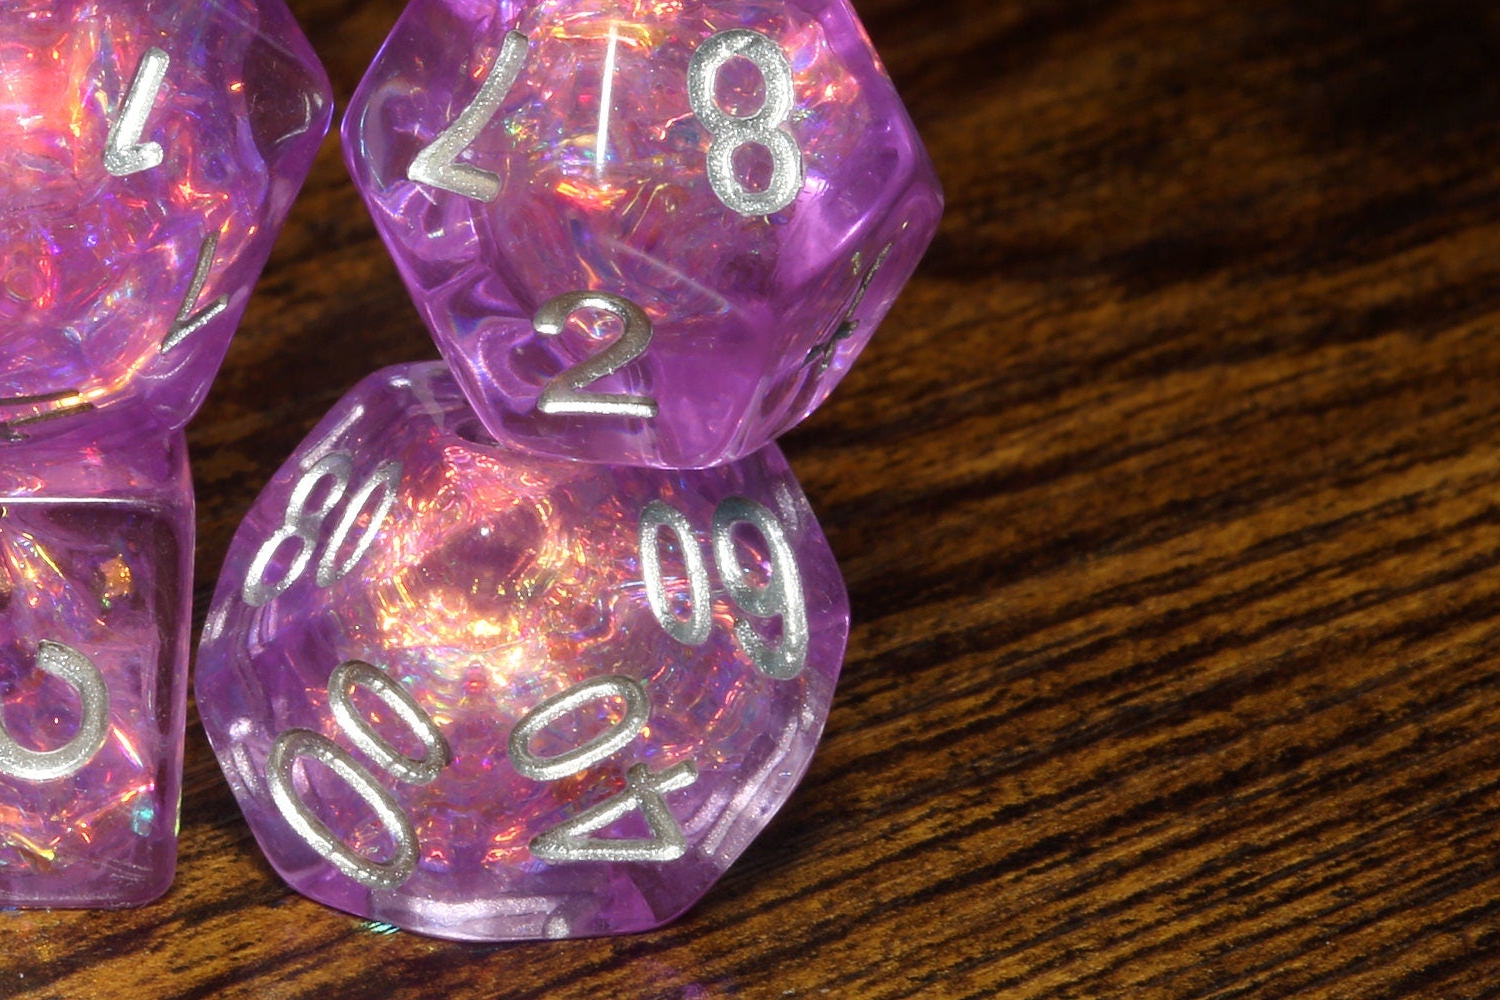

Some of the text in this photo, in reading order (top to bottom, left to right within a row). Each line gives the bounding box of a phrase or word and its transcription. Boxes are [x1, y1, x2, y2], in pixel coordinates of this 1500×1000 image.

[407, 29, 529, 202] 7
[687, 28, 802, 215] 8
[532, 290, 658, 419] 2
[242, 452, 401, 606] 80
